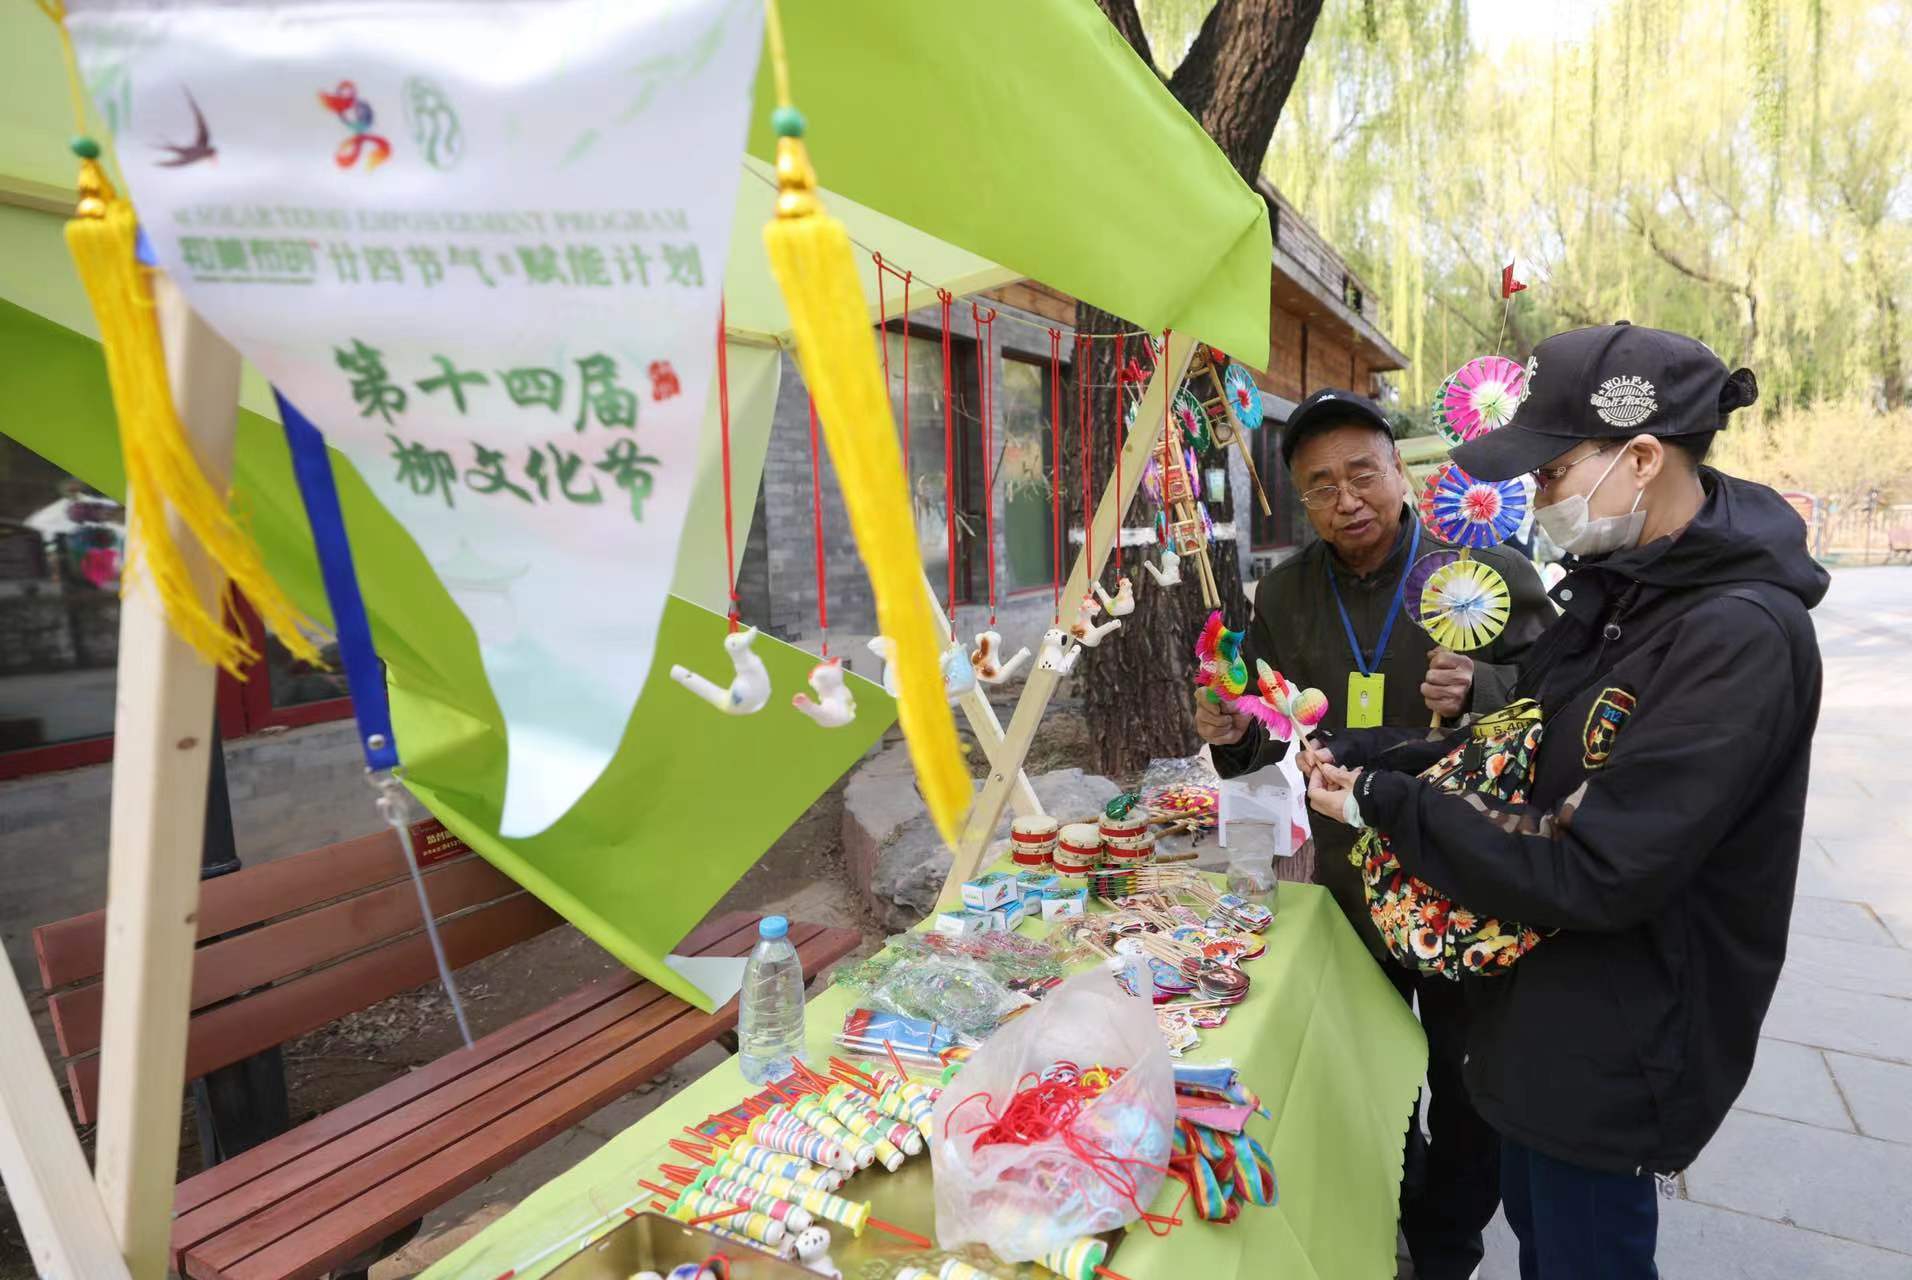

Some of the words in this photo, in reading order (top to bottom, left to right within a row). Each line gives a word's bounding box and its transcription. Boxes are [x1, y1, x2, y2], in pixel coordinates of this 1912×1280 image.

[334, 337, 639, 433] 第十四届
[385, 437, 662, 524] 柳文化节
